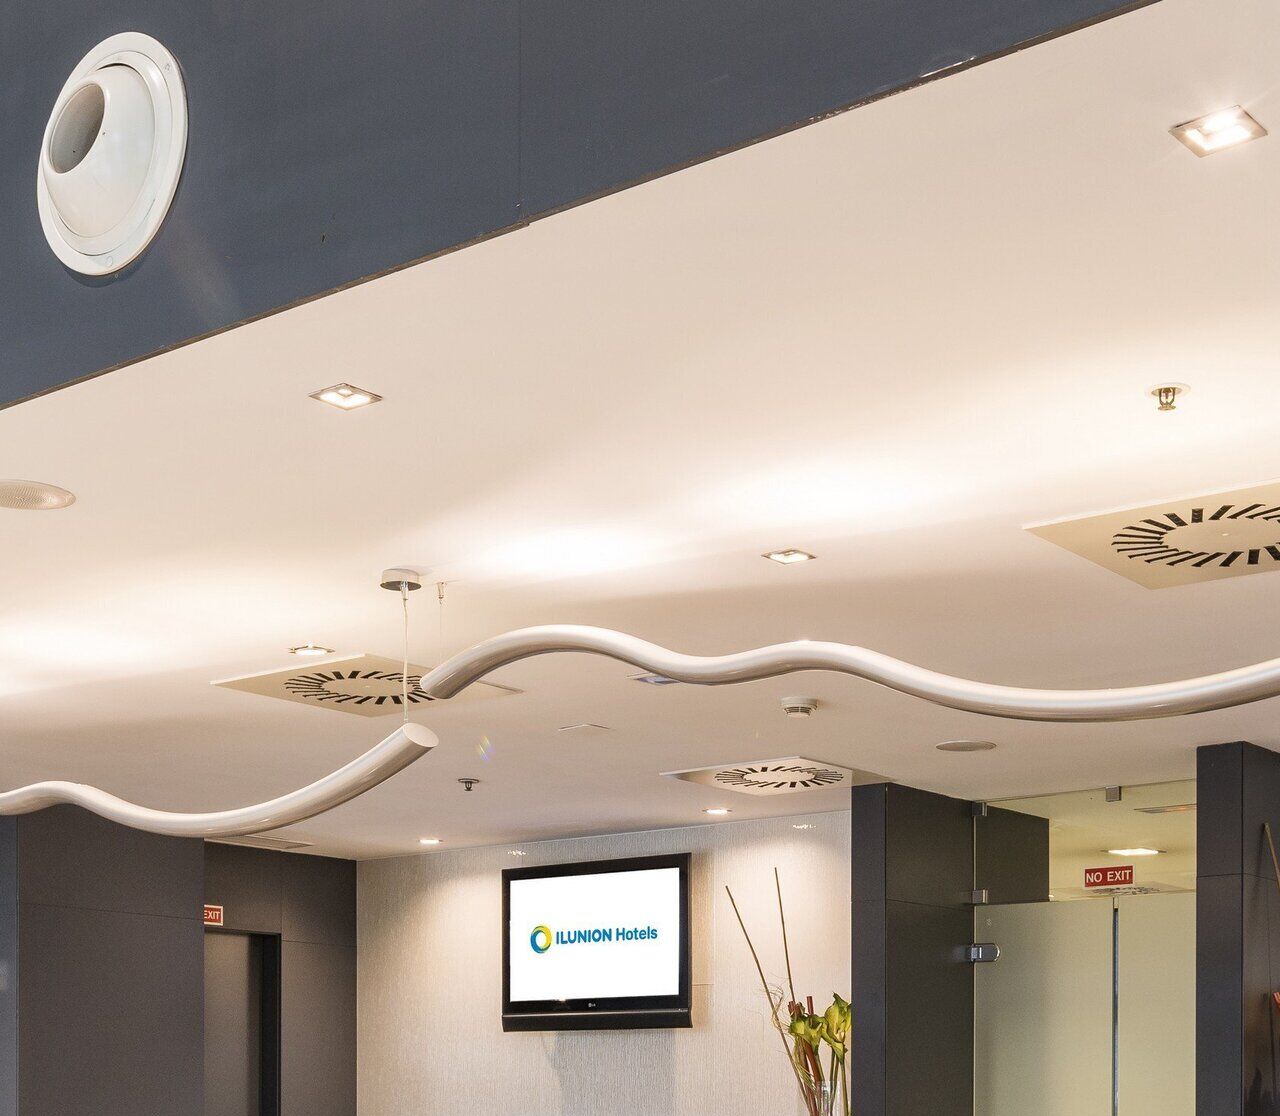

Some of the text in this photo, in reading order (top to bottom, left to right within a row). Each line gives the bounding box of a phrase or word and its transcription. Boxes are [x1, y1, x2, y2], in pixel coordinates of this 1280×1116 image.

[1086, 870, 1132, 883] NO EXIT
[556, 925, 658, 945] ILUNION Hotels
